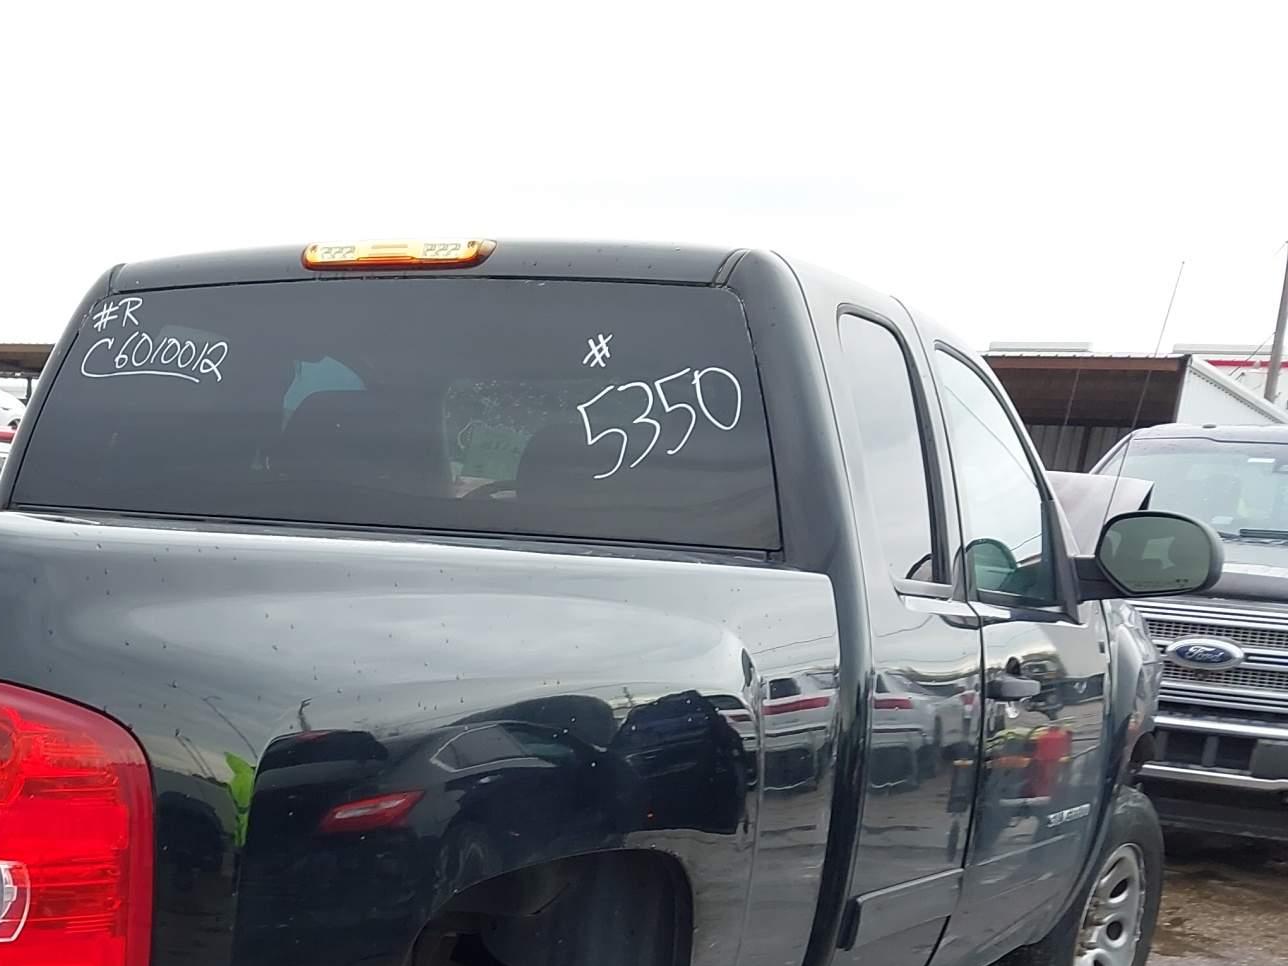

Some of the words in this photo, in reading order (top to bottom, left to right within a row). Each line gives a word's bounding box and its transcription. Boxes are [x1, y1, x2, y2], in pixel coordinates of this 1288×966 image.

[92, 297, 143, 332] #R
[81, 331, 228, 383] C6010012
[582, 333, 613, 367] #
[577, 366, 742, 480] 5350
[1185, 645, 1225, 663] Ford
